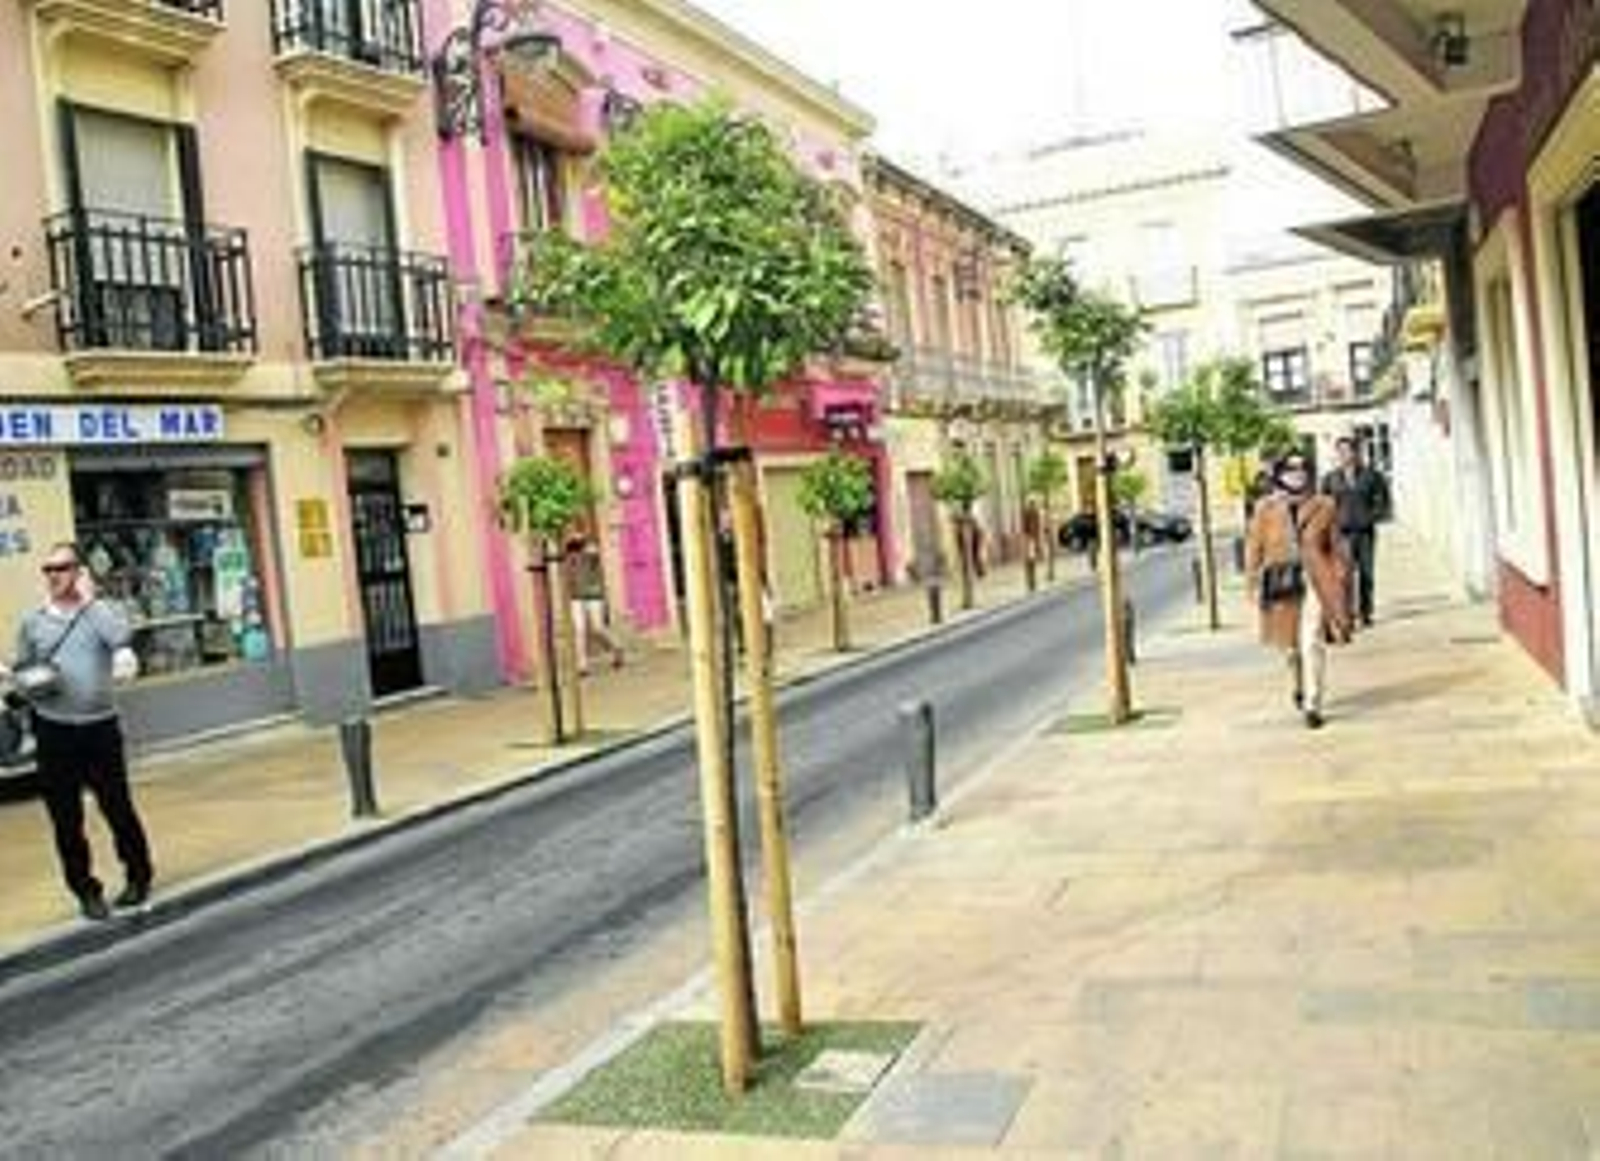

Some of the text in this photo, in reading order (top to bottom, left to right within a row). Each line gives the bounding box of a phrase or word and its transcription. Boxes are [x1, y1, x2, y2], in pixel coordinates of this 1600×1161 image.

[0, 411, 219, 438] EN DEL MAR
